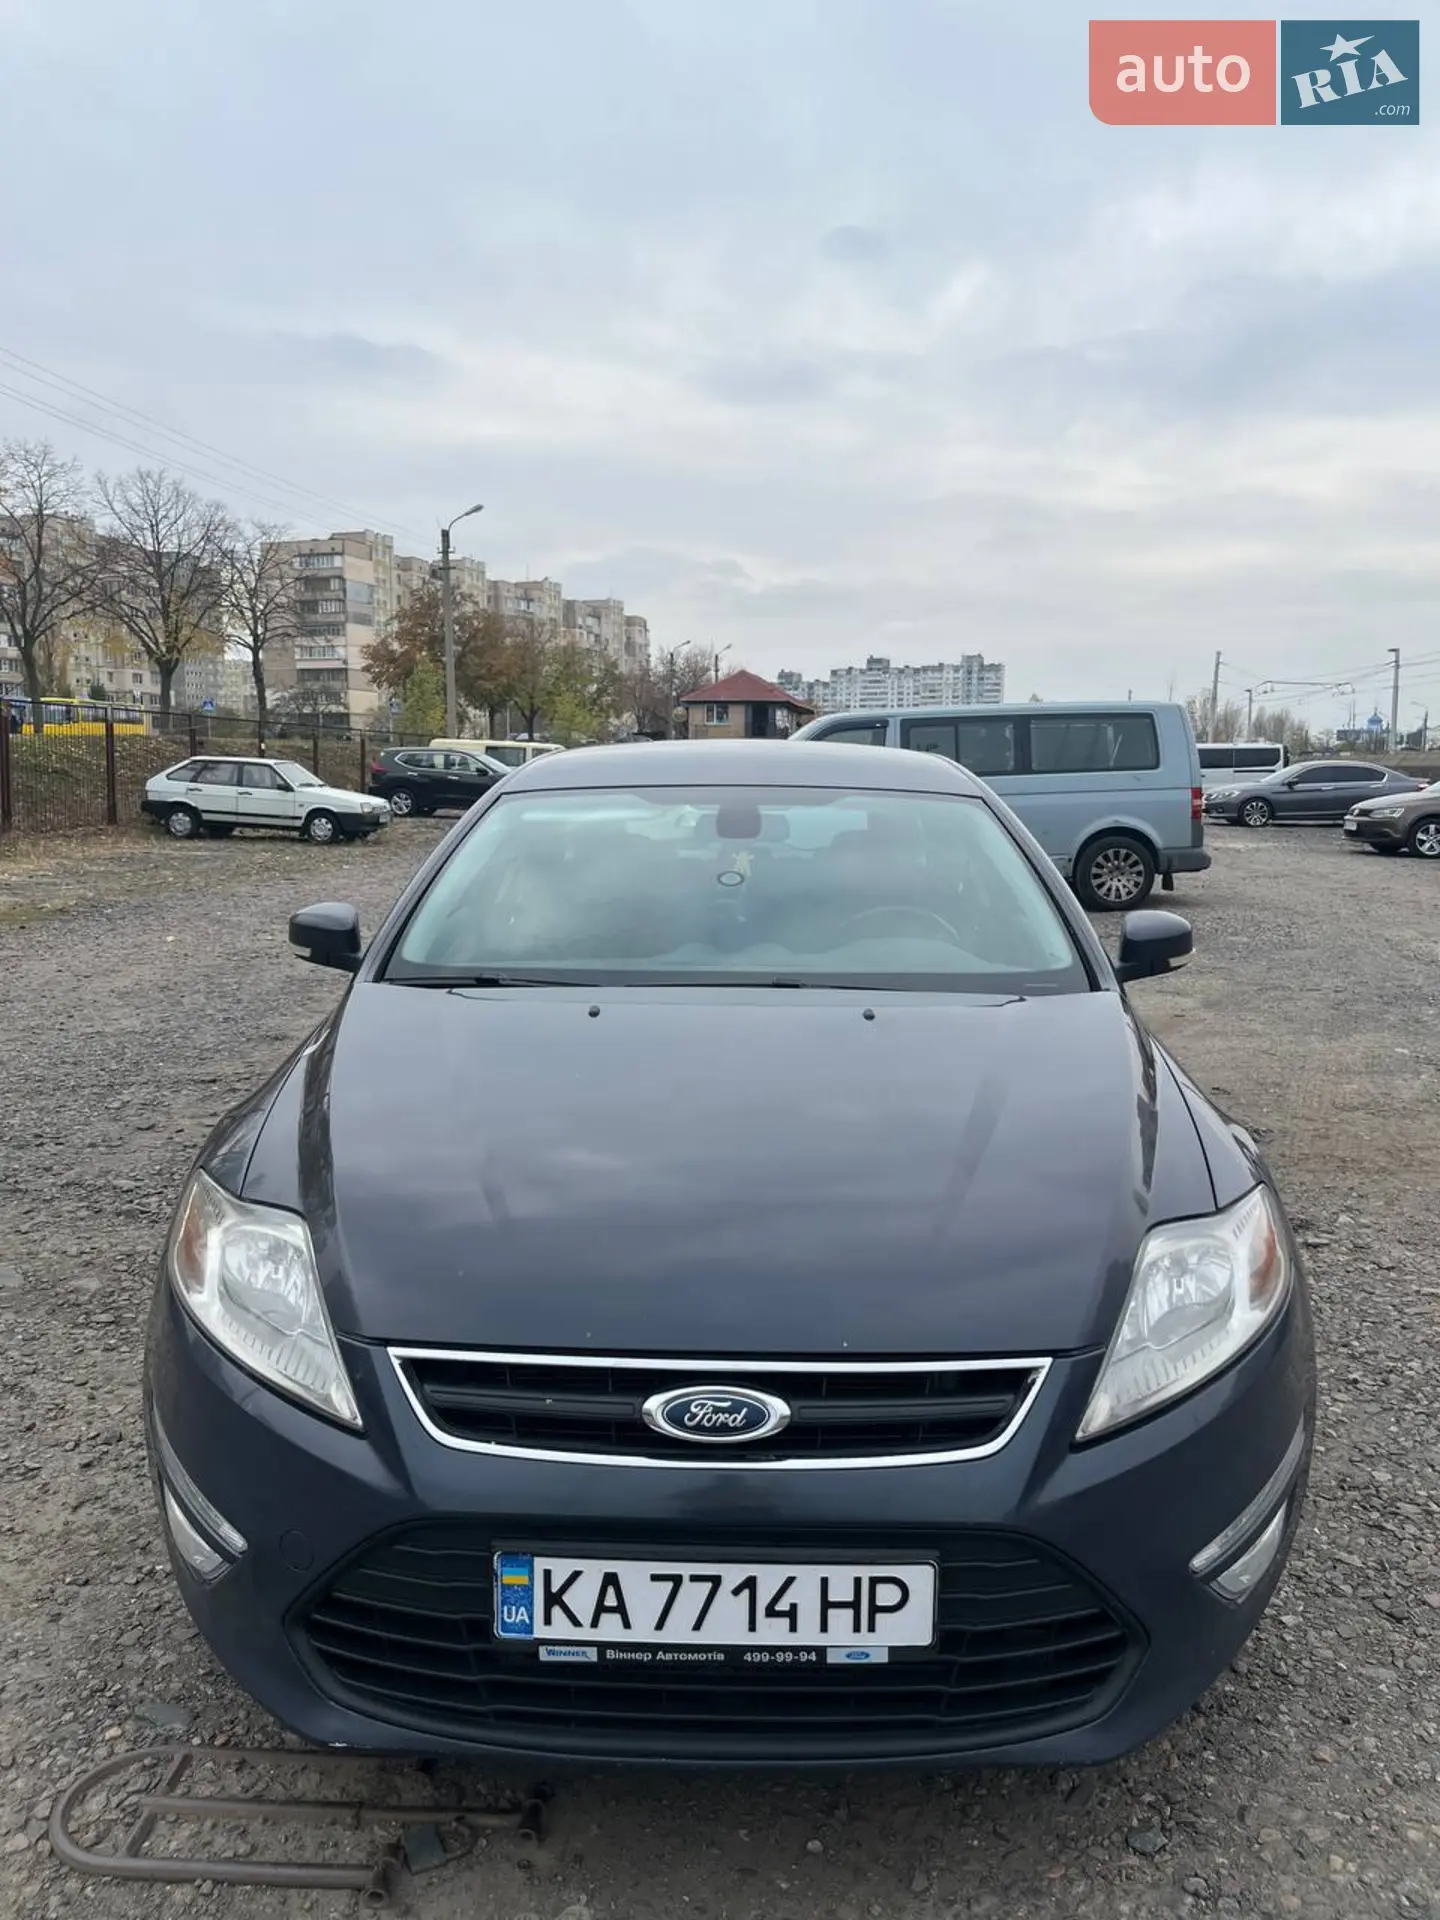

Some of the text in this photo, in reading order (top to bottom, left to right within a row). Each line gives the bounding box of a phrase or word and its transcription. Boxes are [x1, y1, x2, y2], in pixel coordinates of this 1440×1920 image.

[684, 1400, 748, 1427] Ford
[543, 1568, 910, 1633] KA 7714 HP
[503, 1606, 530, 1624] UA
[605, 1649, 652, 1661] Віннер
[743, 1651, 817, 1662] 499-99-94
